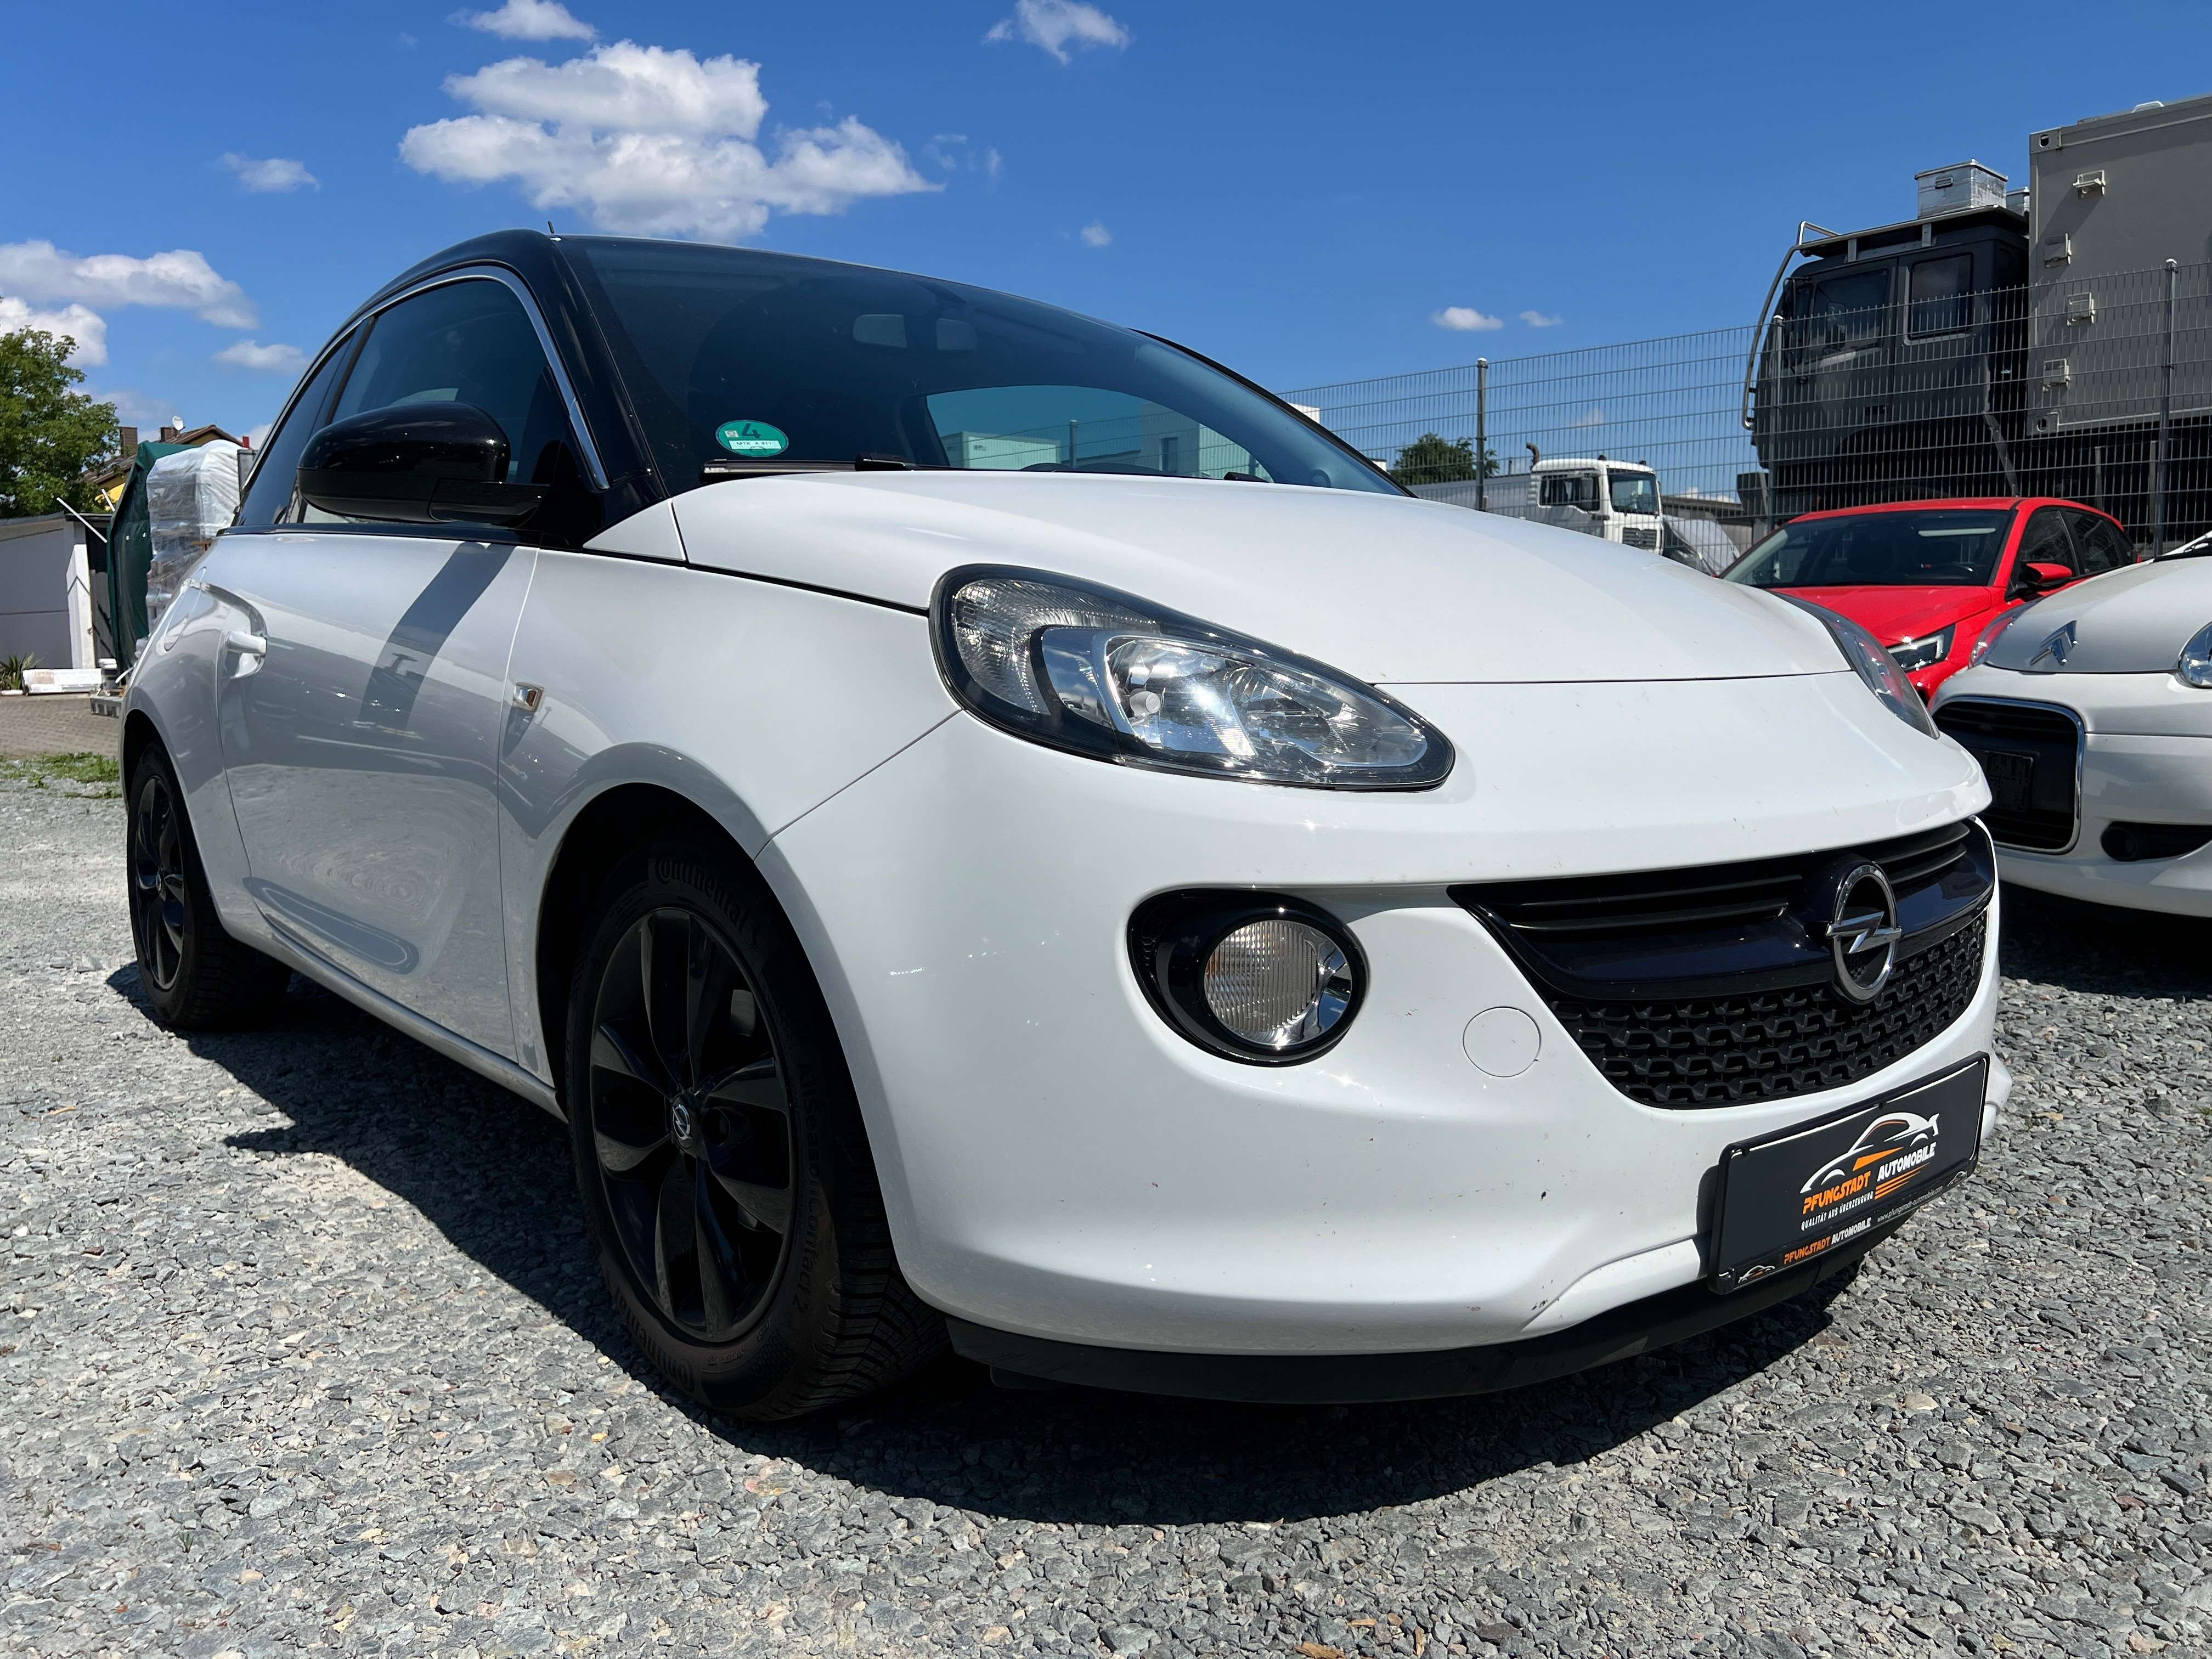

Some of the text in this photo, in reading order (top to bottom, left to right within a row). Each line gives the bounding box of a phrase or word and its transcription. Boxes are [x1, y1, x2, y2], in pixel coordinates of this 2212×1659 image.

[741, 423, 761, 439] 4
[654, 850, 753, 934] Continental
[1803, 1142, 1937, 1215] PFUNGSTADT AUTOMOBILE
[1801, 1190, 1874, 1231] QUALITÄT AUS ÜBERZEUGUNG
[1784, 1236, 1831, 1265] PFUNGSTADT
[1831, 1217, 1871, 1244] AUTOMOBILE
